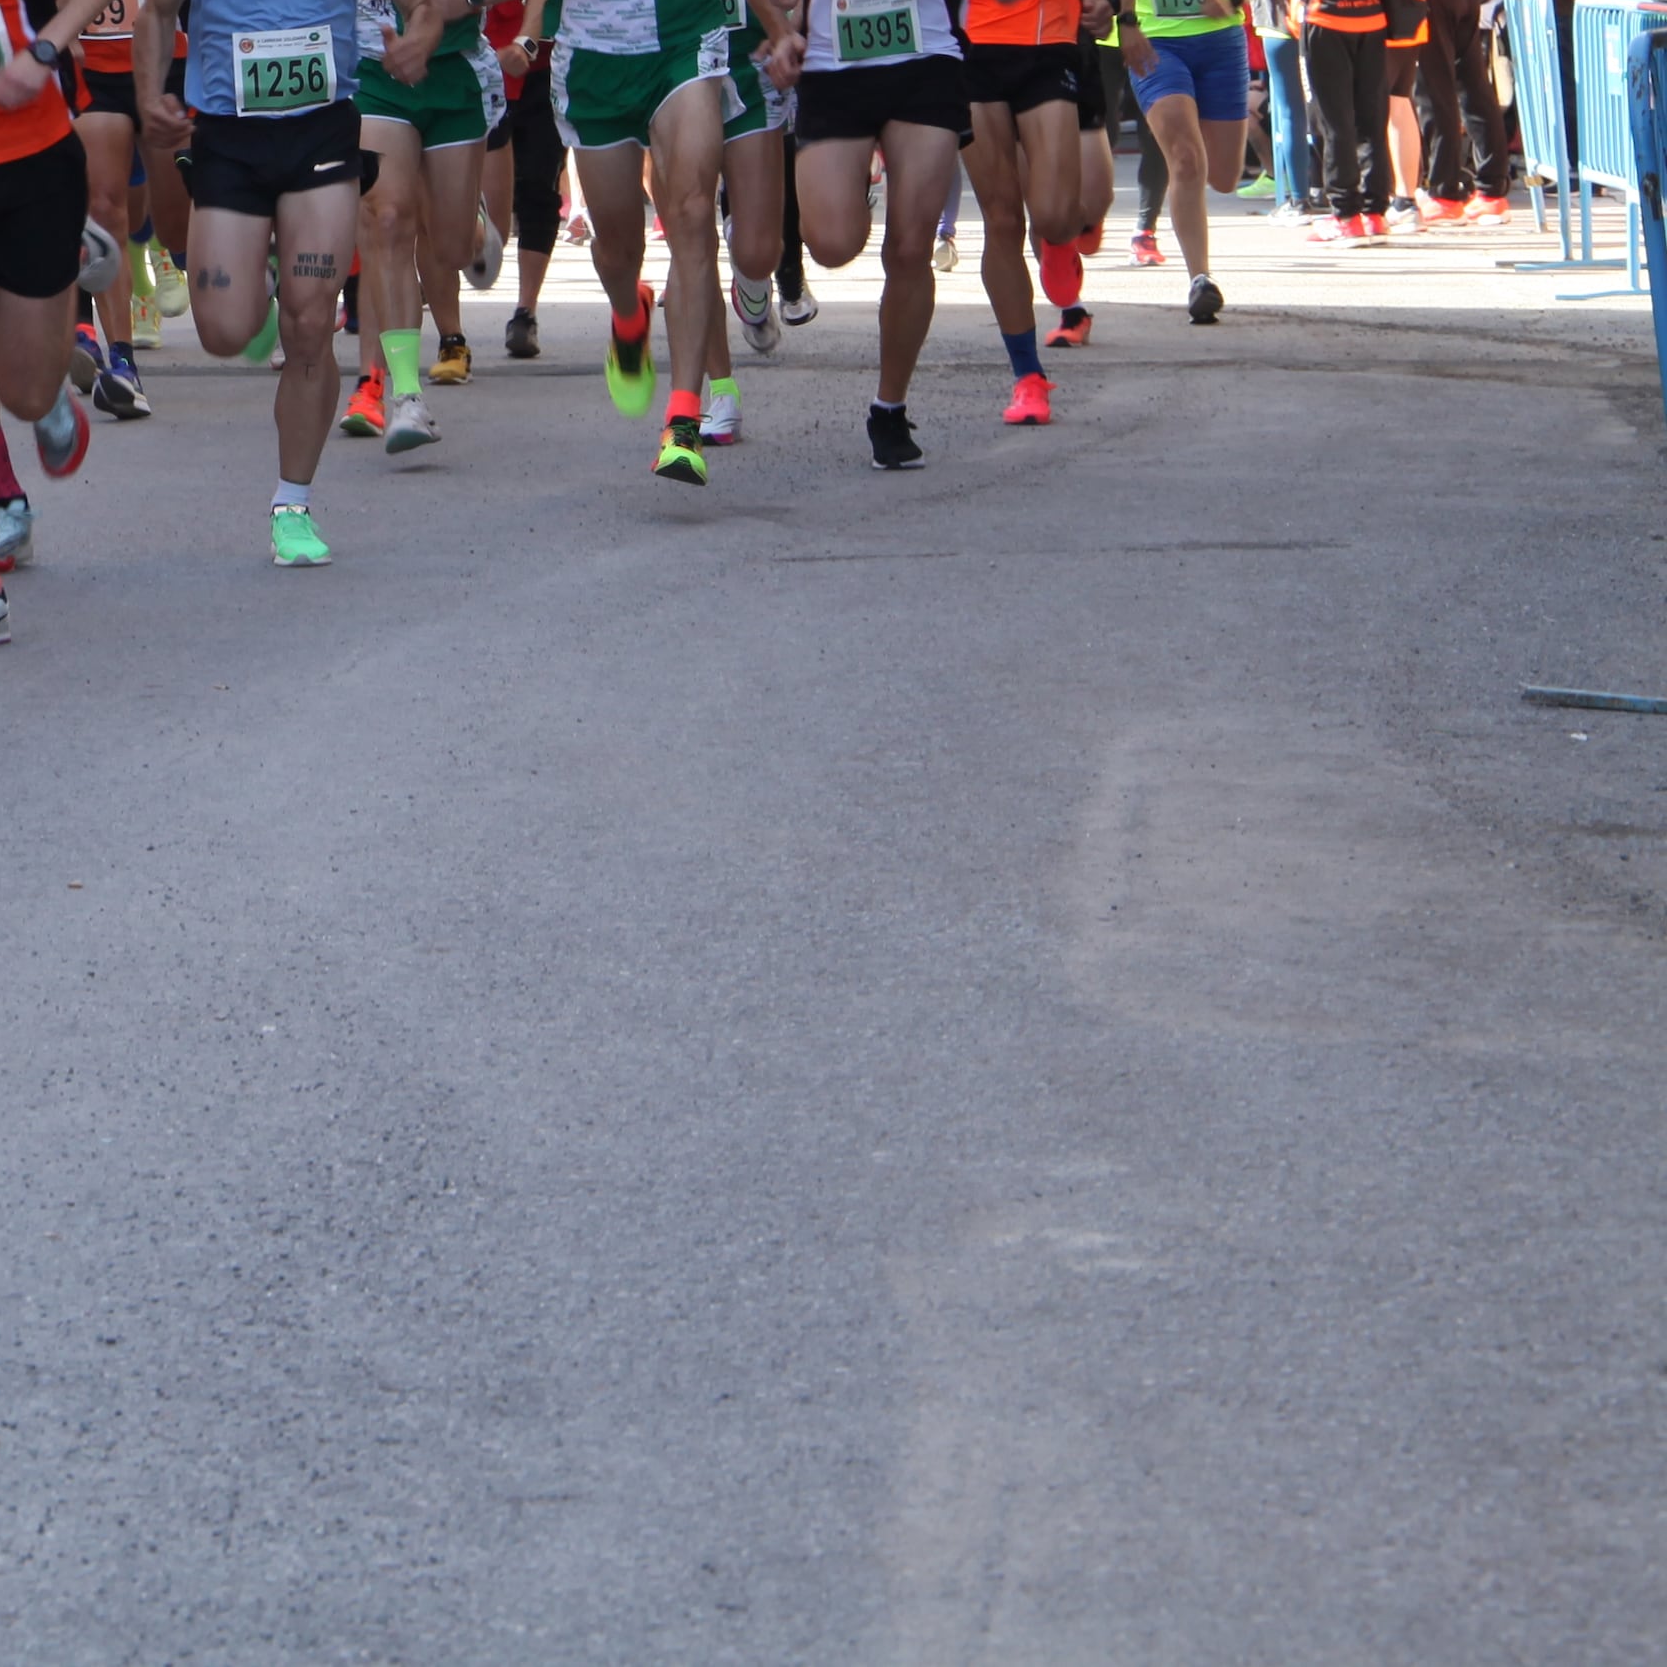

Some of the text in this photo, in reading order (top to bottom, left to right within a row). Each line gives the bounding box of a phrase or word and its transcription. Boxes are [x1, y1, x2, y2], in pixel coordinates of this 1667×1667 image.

[842, 12, 911, 50] 1395
[247, 56, 324, 98] 1256
[293, 264, 337, 279] SERIOUS?
[298, 253, 335, 266] WHY SO
